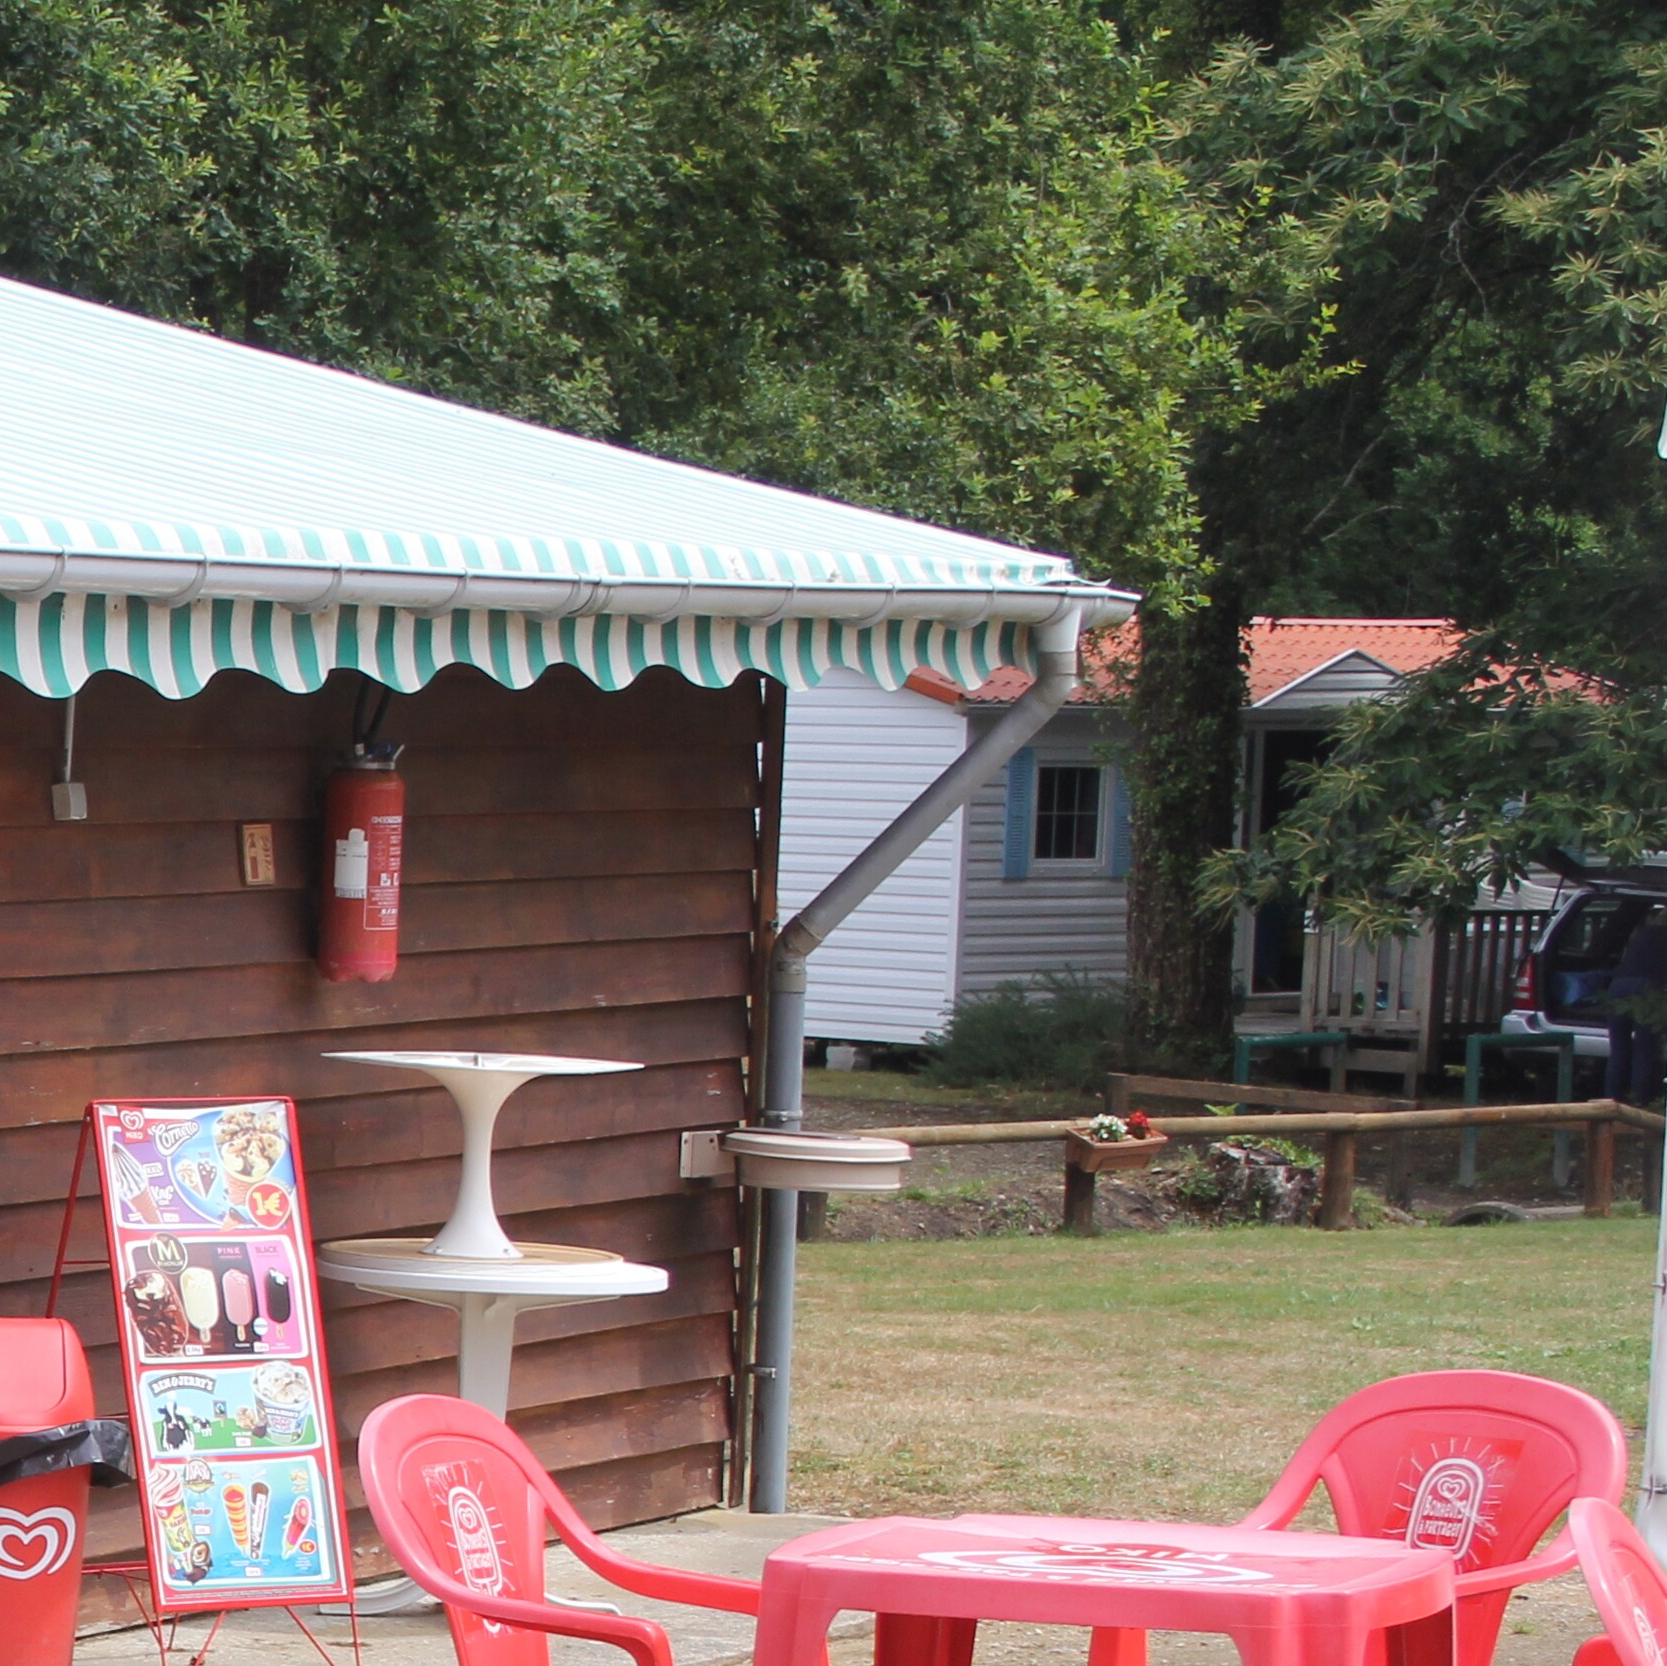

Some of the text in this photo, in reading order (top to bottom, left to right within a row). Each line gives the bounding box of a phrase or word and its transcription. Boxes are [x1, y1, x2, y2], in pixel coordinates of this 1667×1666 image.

[252, 1191, 284, 1217] 1€
[217, 1246, 241, 1255] PINK
[1058, 1543, 1230, 1563] MIKO
